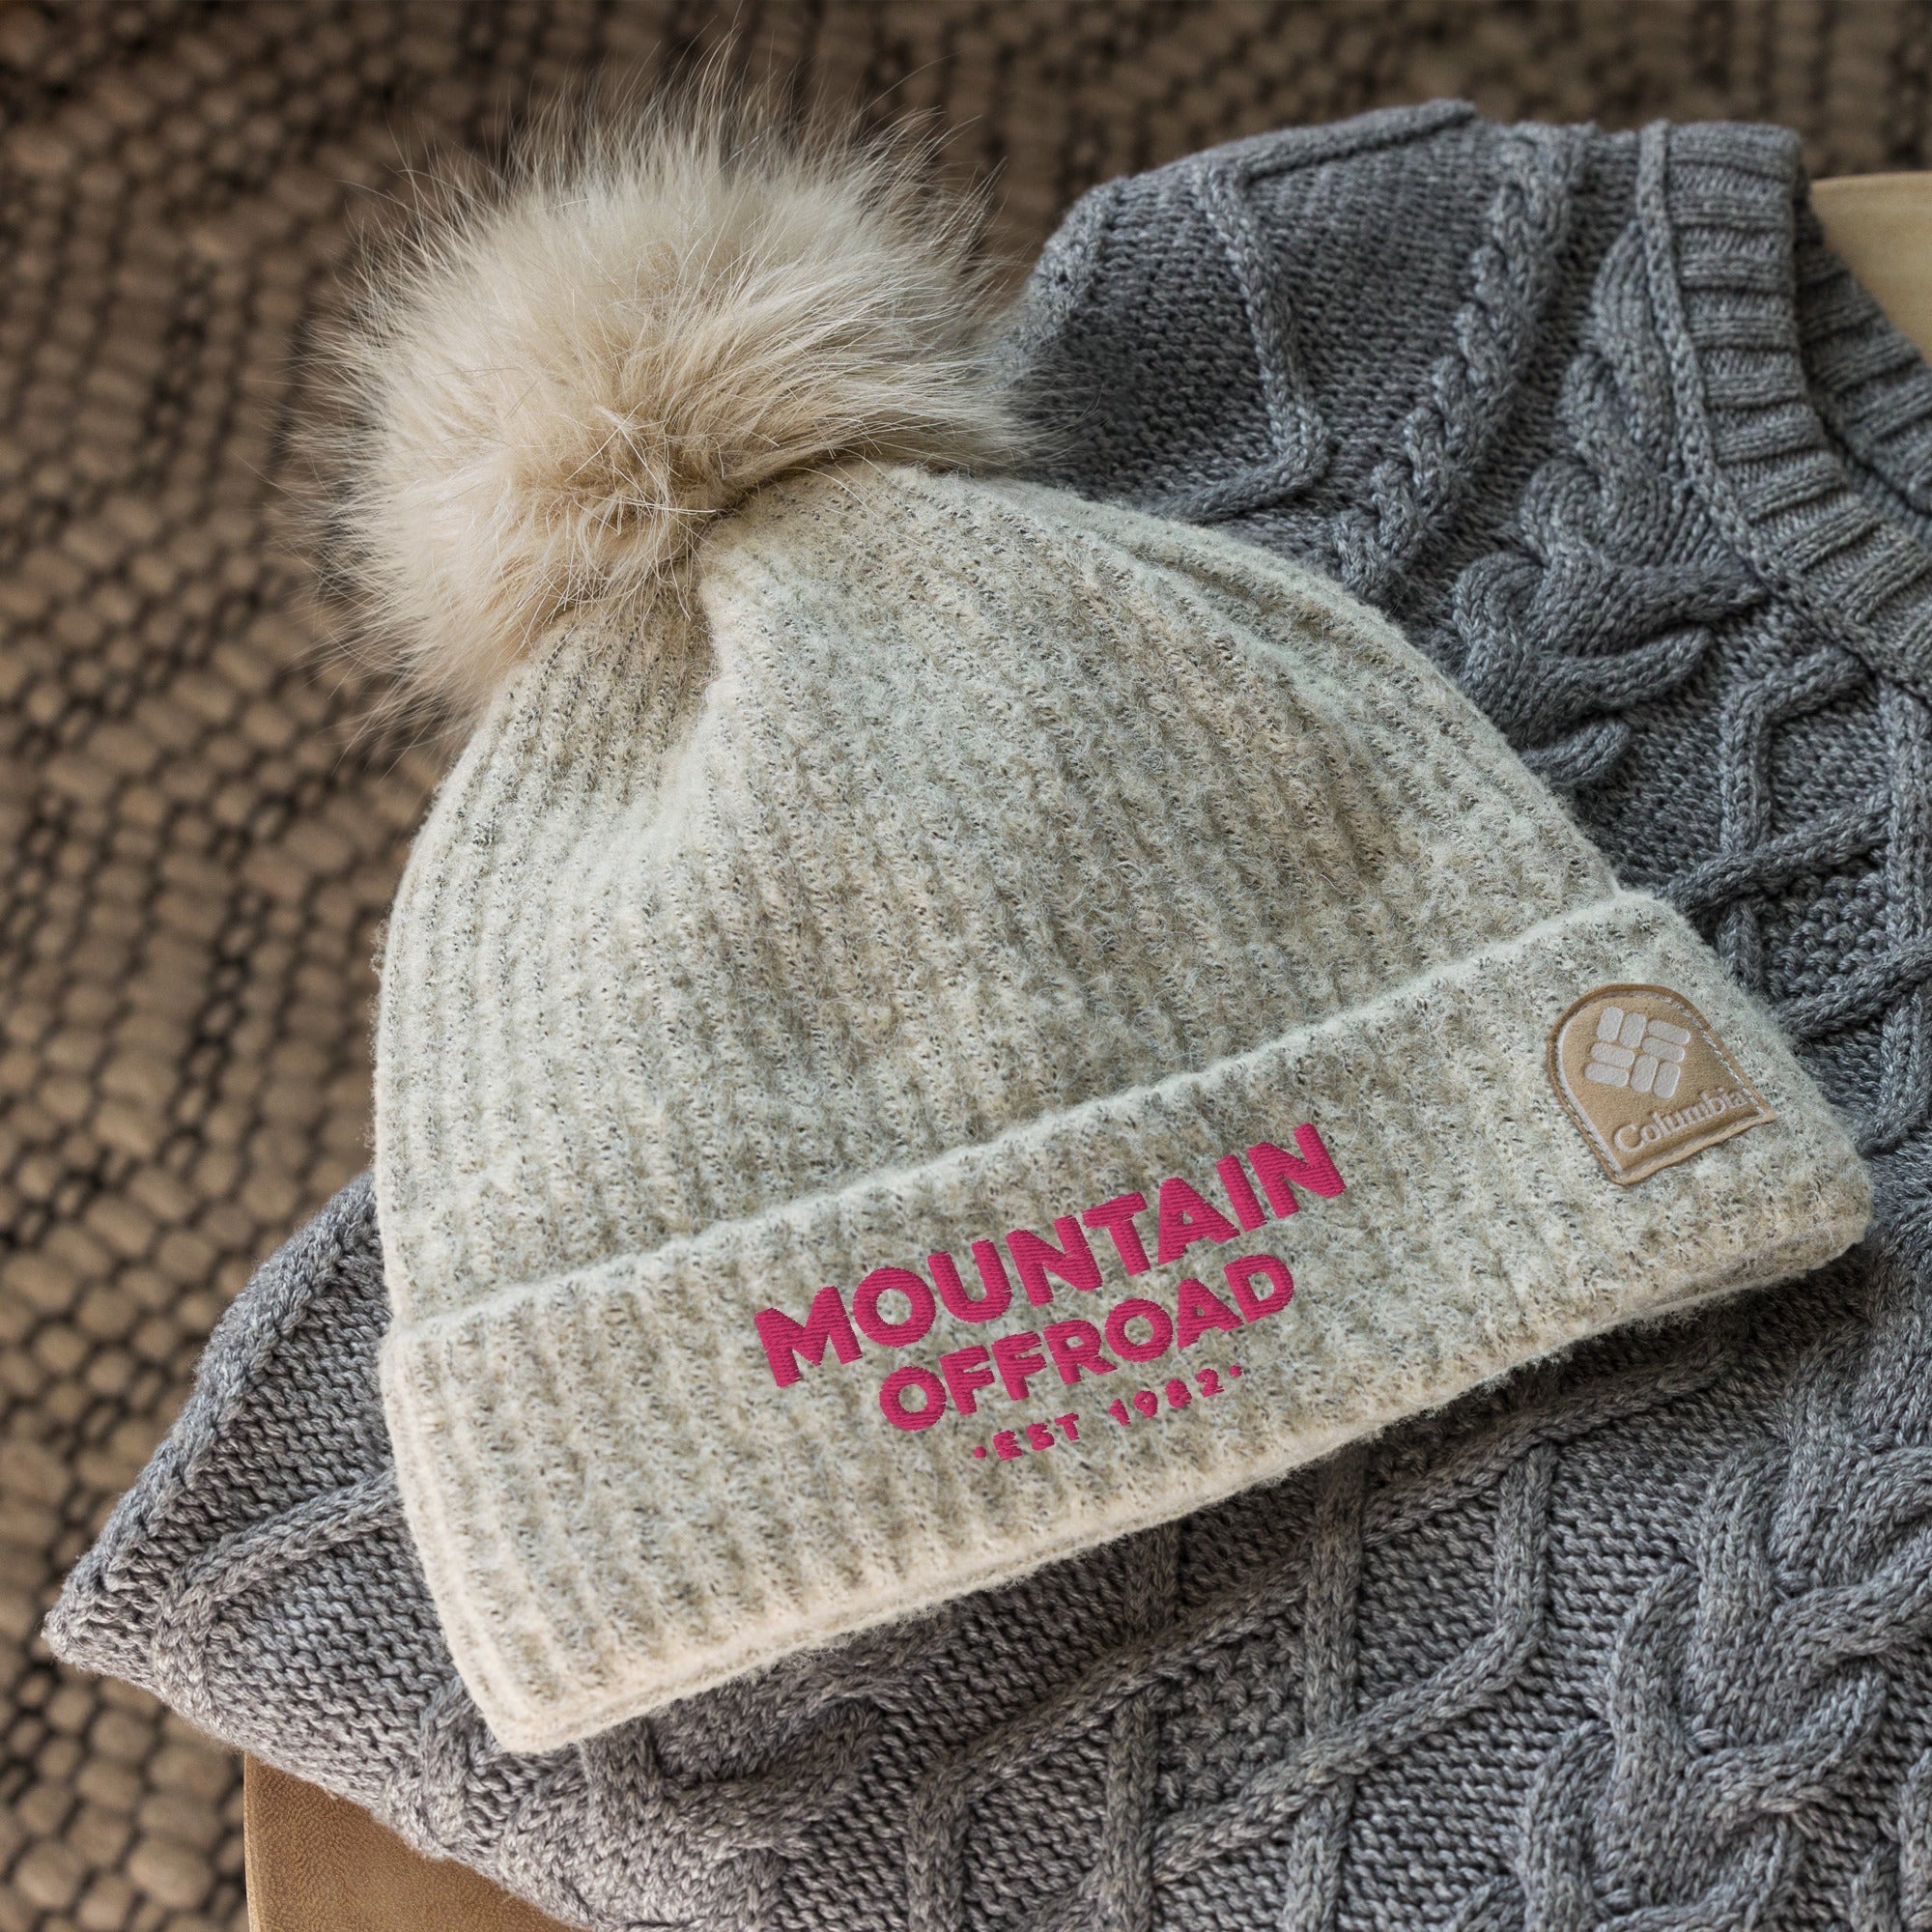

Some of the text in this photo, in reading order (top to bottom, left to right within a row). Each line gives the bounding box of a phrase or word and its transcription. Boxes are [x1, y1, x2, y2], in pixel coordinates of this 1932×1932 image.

[1613, 1087, 1748, 1153] Columbia
[754, 1123, 1347, 1387] MOUNTAIN
[879, 1254, 1293, 1431] OFFROAD
